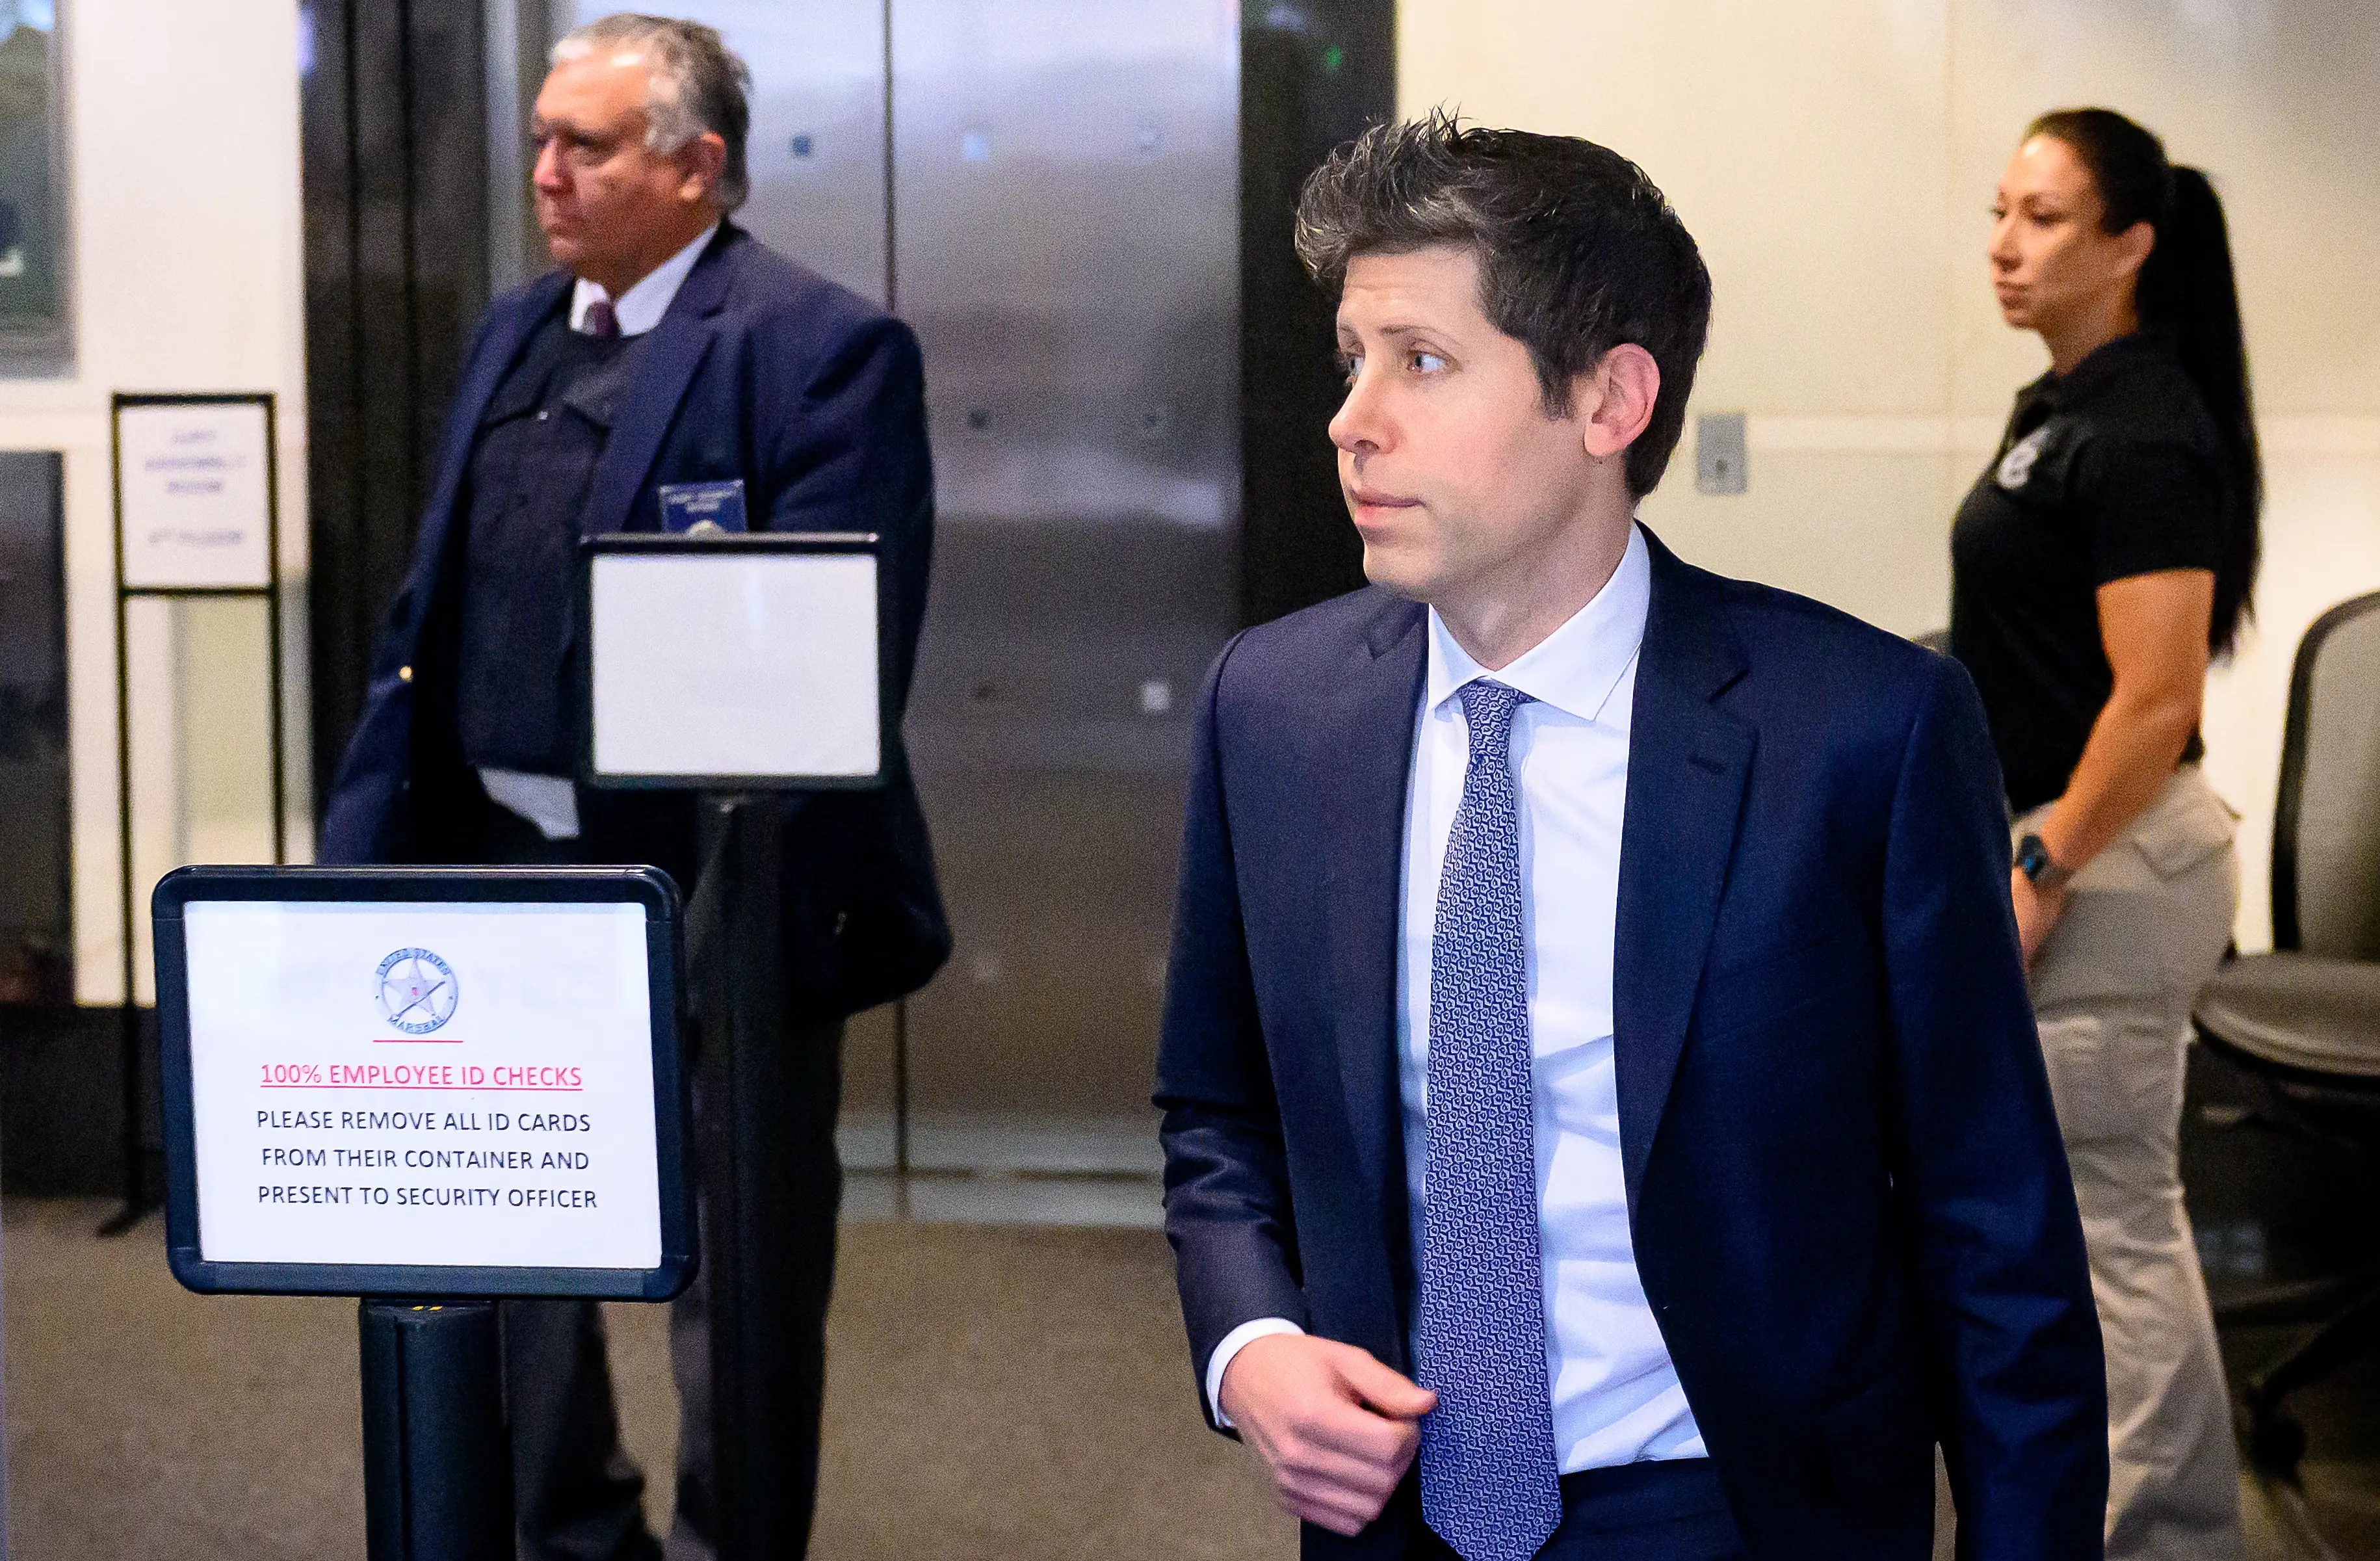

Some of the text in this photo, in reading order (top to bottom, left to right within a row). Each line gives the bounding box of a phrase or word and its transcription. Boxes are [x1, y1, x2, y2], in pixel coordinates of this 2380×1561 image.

[261, 1064, 582, 1086] 100% EMPLOYEE ID CHECKS
[257, 1110, 590, 1131] PLEASE REMOVE ALL ID CARDS
[263, 1148, 589, 1170] FROM THEIR CONTAINER AND
[259, 1186, 597, 1208] PRESENT TO SECURITY OFFICER
